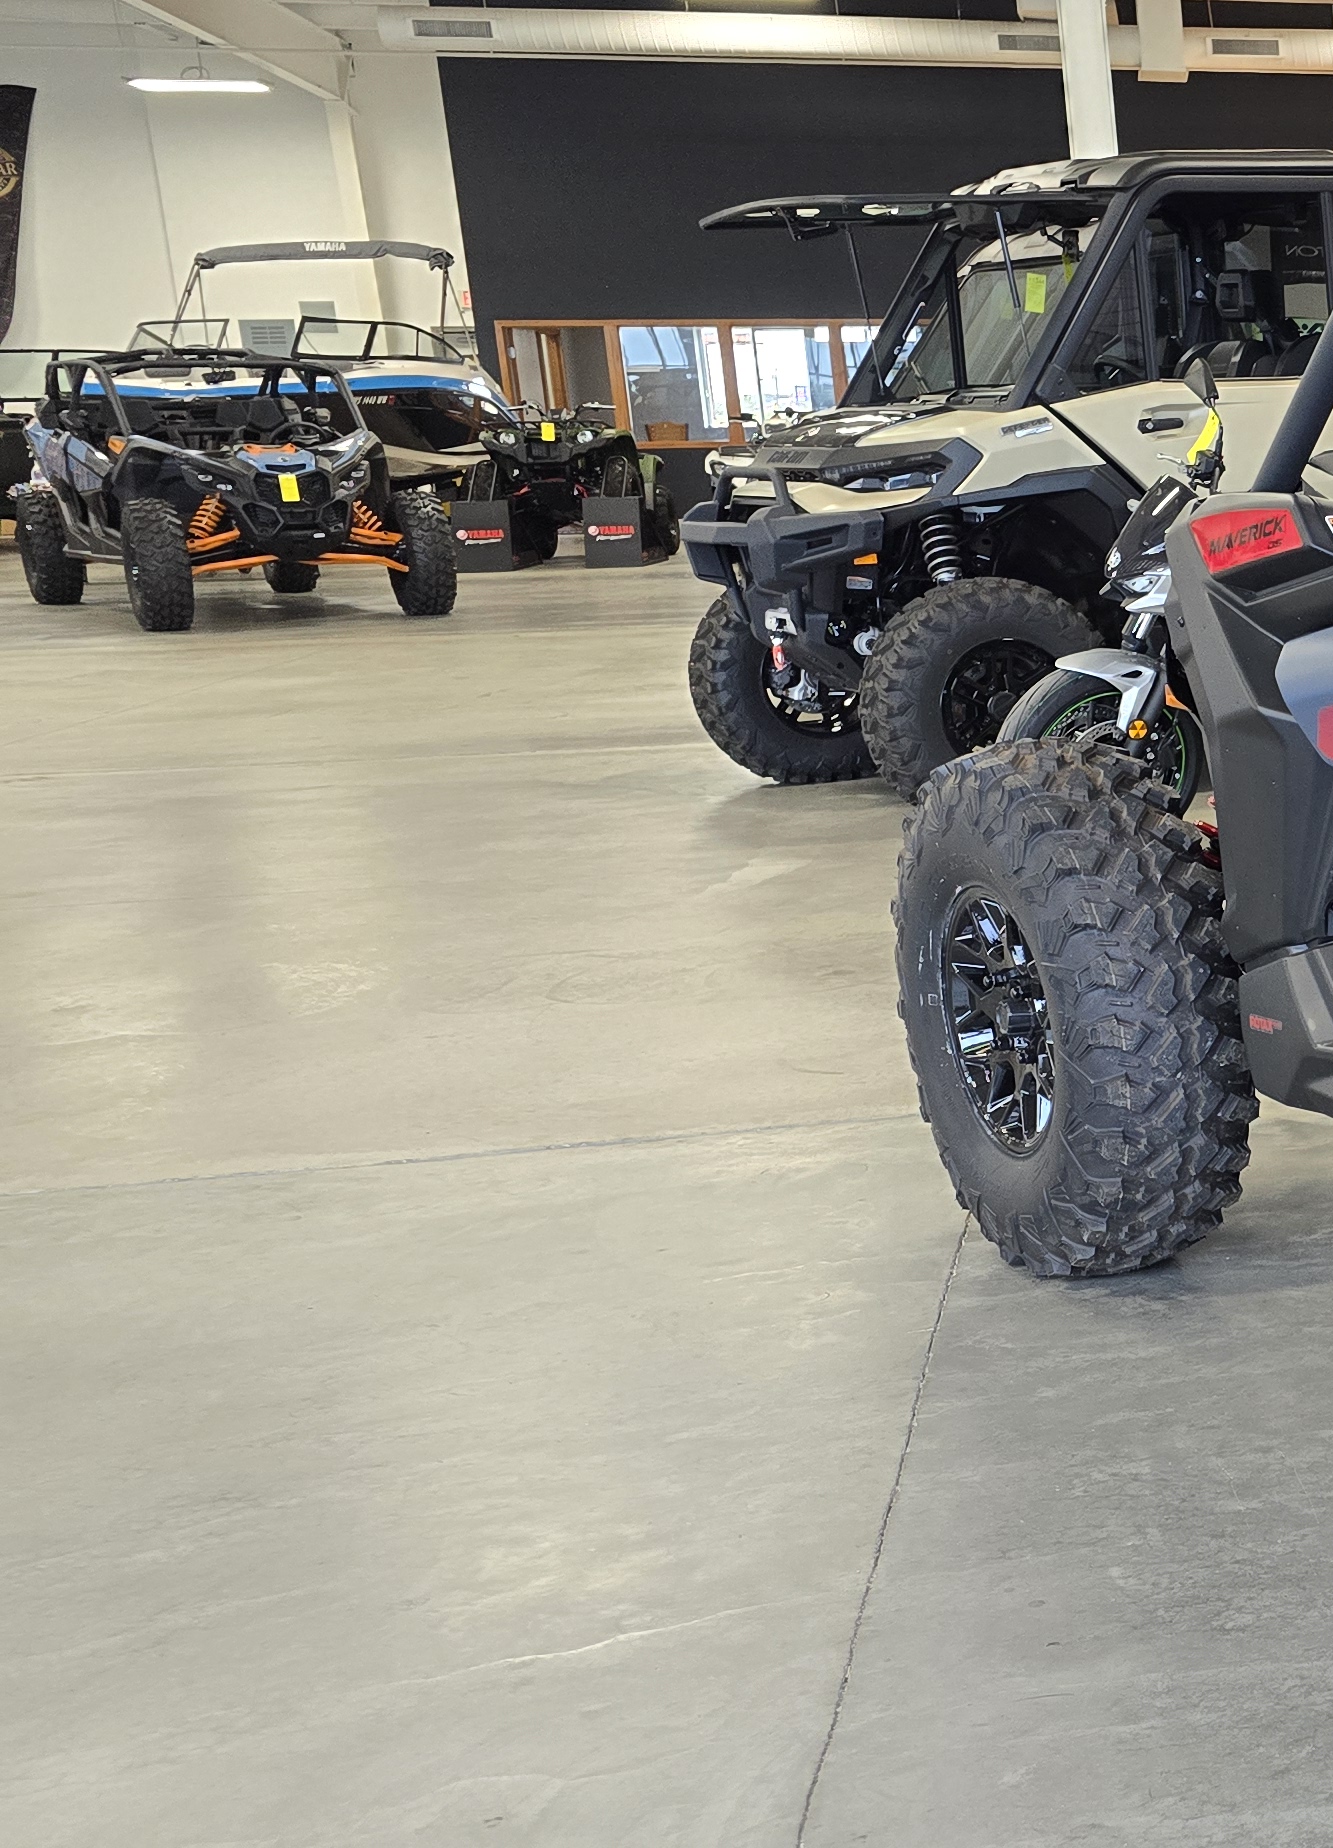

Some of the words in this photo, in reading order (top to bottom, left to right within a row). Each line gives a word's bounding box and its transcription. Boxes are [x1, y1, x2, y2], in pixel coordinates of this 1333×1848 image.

[303, 242, 346, 251] YAMAHA
[468, 529, 504, 538] YAMAHA
[599, 525, 635, 535] YAMAHA
[1208, 514, 1287, 557] MAVERICK
